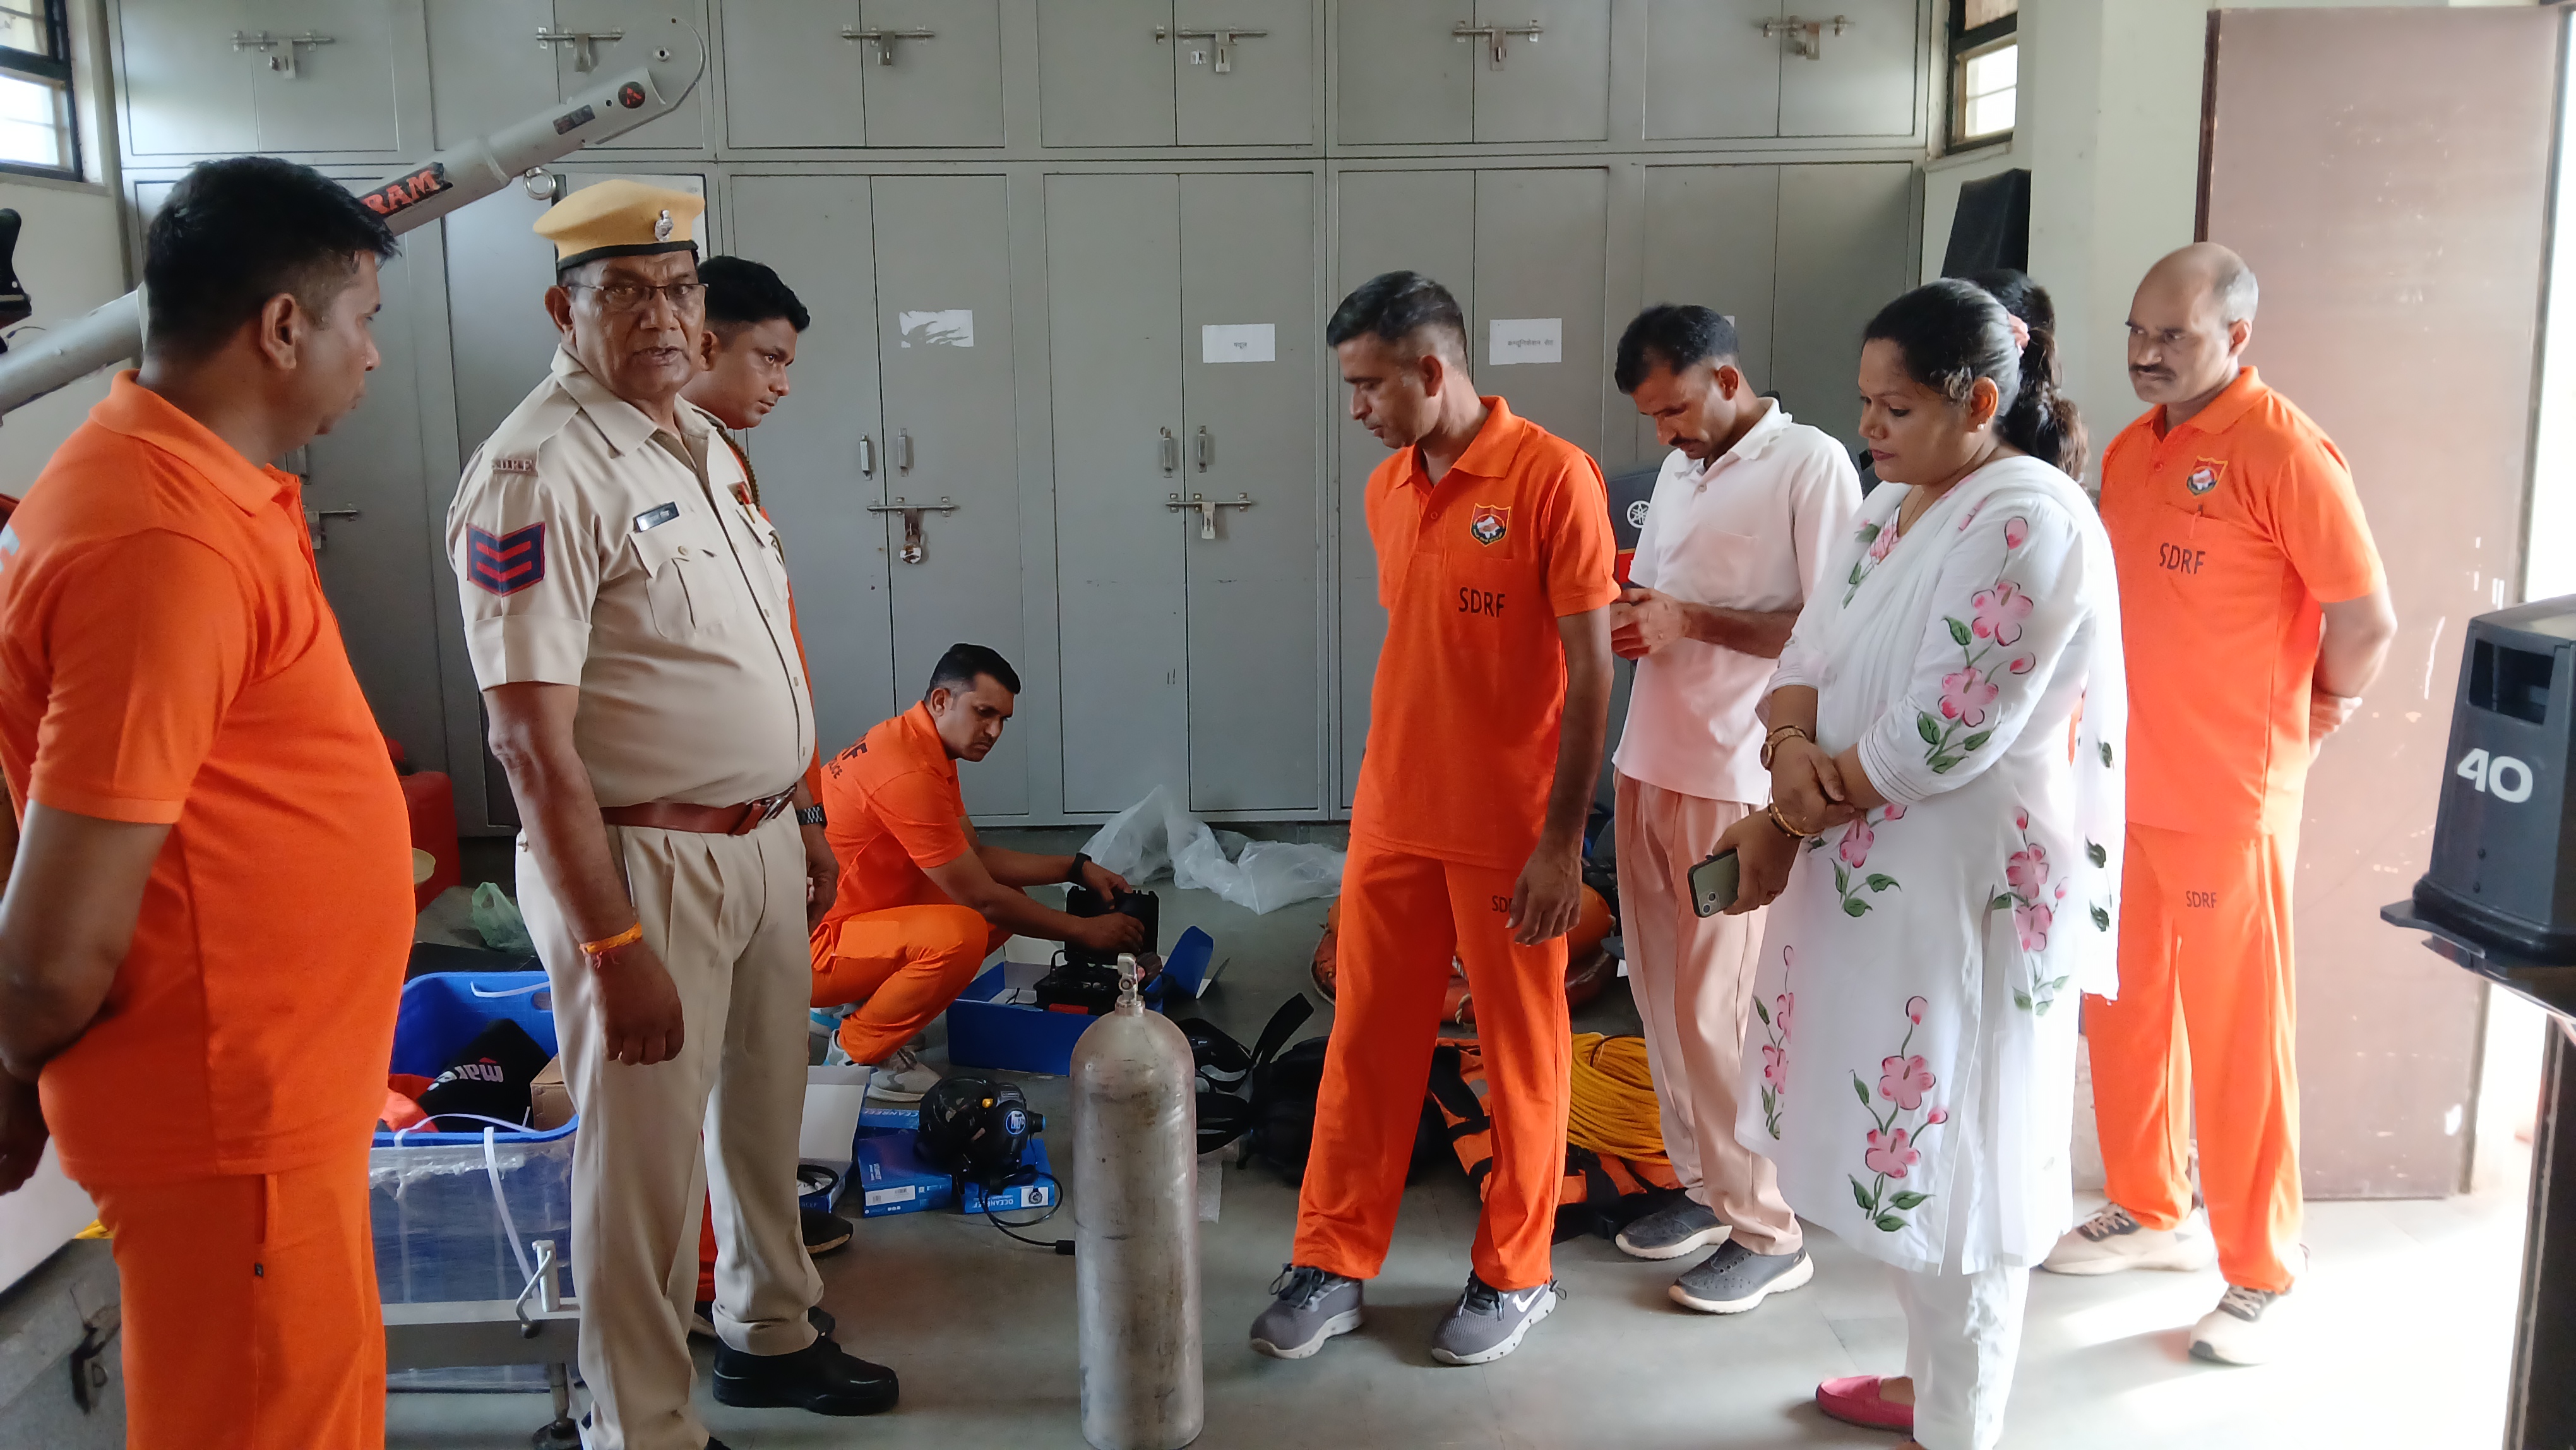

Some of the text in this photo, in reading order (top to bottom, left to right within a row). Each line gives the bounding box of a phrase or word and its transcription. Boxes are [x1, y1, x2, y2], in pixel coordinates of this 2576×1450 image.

[2159, 542, 2206, 575] SDRF
[1458, 587, 1506, 618] SDRF
[2457, 747, 2533, 803] 40
[1491, 895, 1513, 913] SD
[2186, 890, 2217, 909] SDRF
